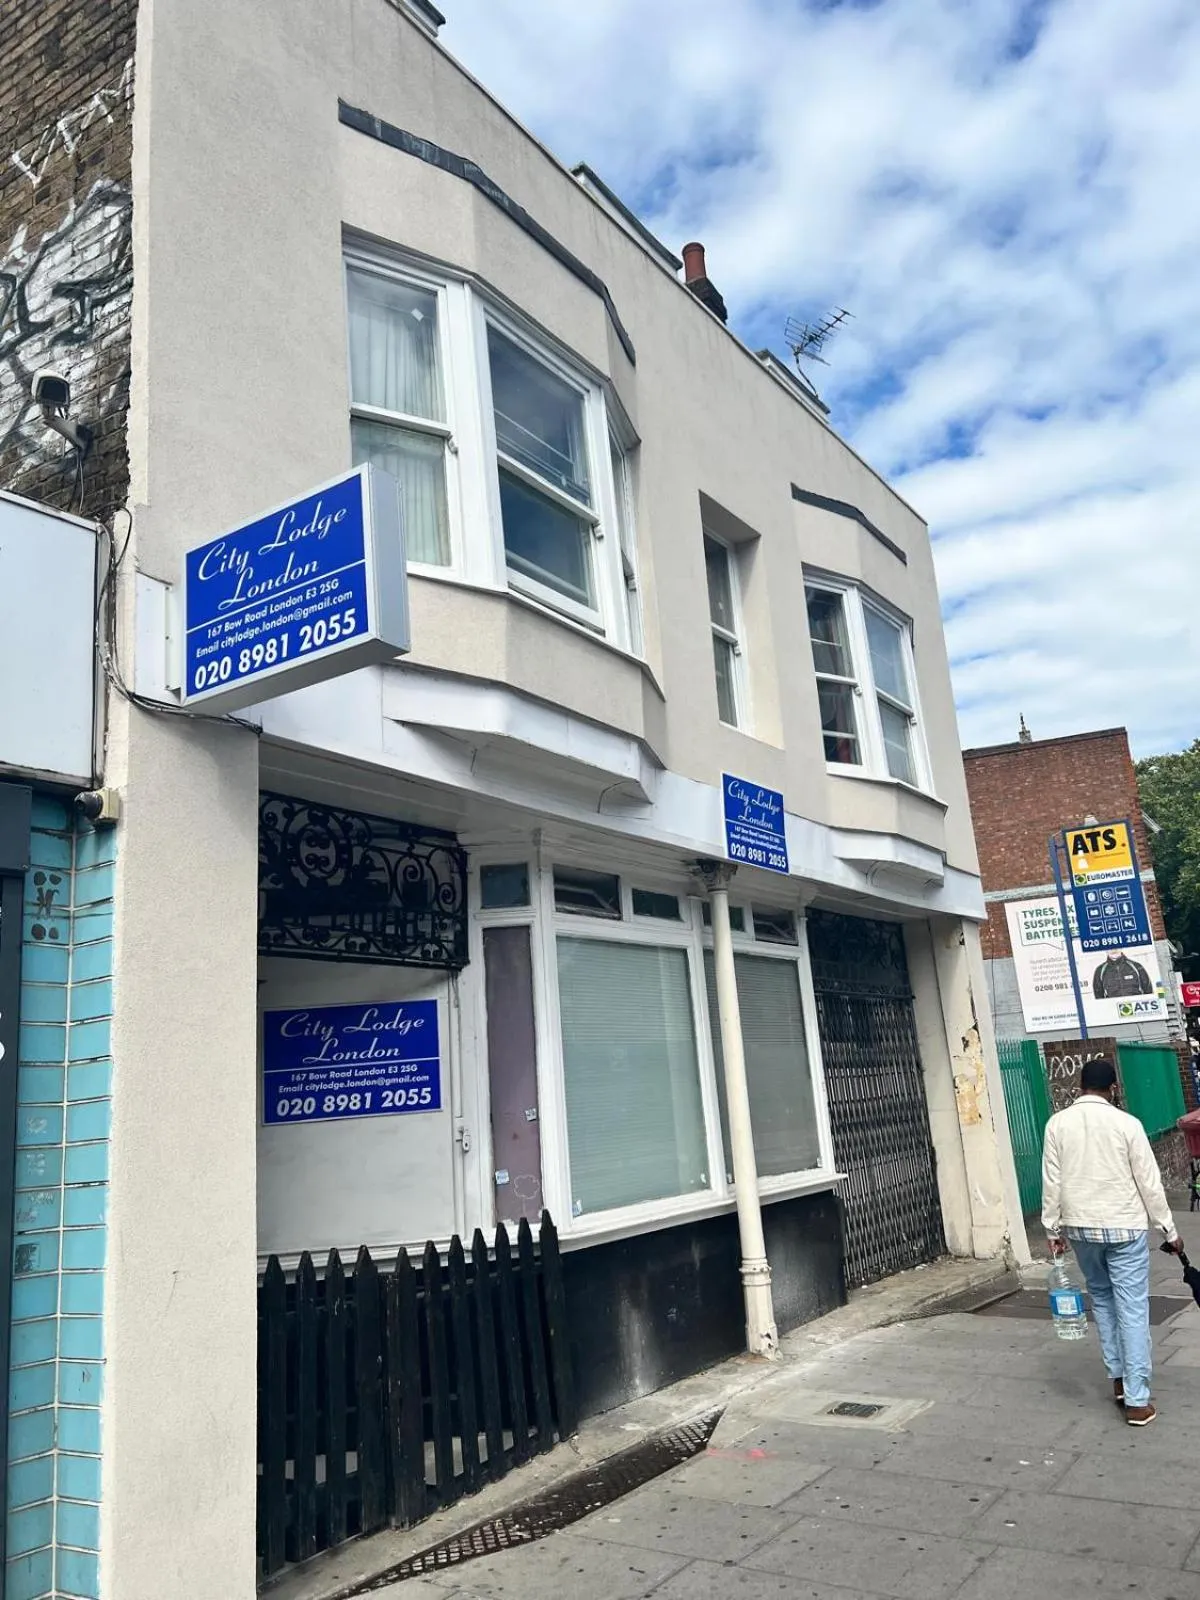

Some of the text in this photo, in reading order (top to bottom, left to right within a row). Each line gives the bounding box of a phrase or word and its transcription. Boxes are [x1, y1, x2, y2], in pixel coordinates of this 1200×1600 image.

[198, 500, 347, 581] City Lodge
[217, 551, 320, 611] London
[207, 578, 340, 639] 167 Bow Road London E3 2SG
[195, 590, 354, 658] Email citylodge.london@gmail.com
[194, 608, 357, 690] 020 8981 2055
[728, 780, 781, 816] City Lodge
[737, 805, 774, 830] London
[1072, 828, 1117, 855] ATS
[730, 842, 747, 858] 020
[748, 846, 766, 864] 8981
[768, 852, 787, 869] 2055
[1087, 868, 1133, 882] EUROMASTER
[1022, 907, 1059, 919] TYRES,
[1083, 933, 1148, 948] 020 8981 2618
[1134, 1000, 1159, 1012] ATS
[280, 1007, 425, 1042] City Lodge
[302, 1037, 401, 1065] London
[278, 1074, 430, 1094] Email citylodge.london@gmail.com
[291, 1063, 419, 1082] 167 Bow Road London E3 2SG
[276, 1087, 433, 1117] 020 8981 2055
